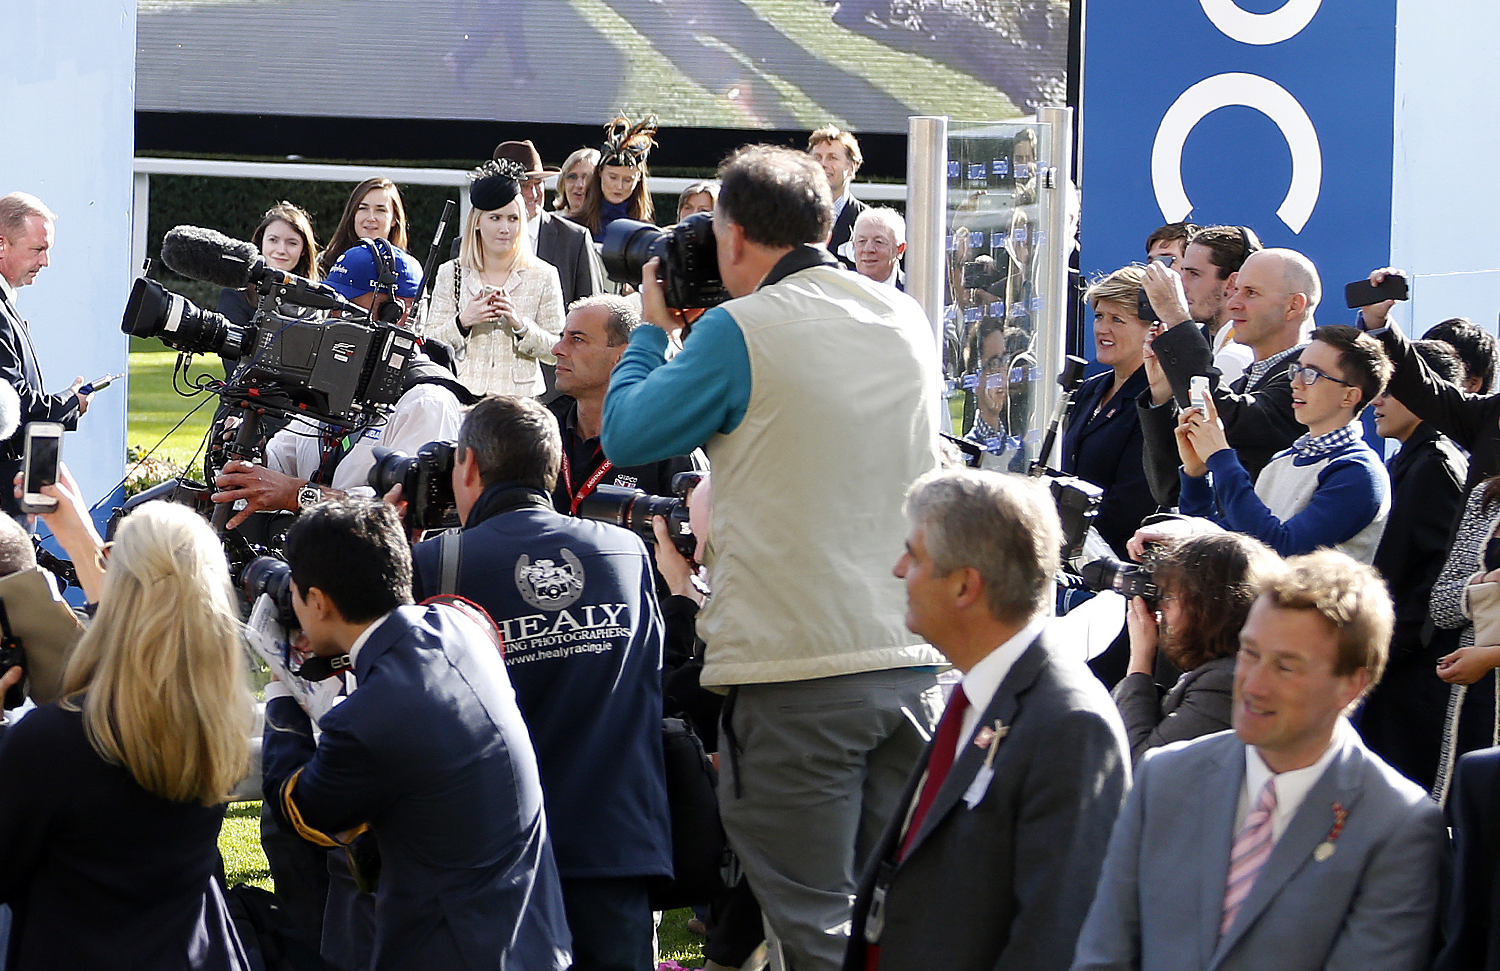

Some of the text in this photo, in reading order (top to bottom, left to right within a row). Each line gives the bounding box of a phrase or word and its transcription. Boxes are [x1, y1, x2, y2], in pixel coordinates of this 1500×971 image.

[503, 627, 633, 654] ING PHOTOGRAPHERS
[505, 640, 613, 666] www.healyracing.ie
